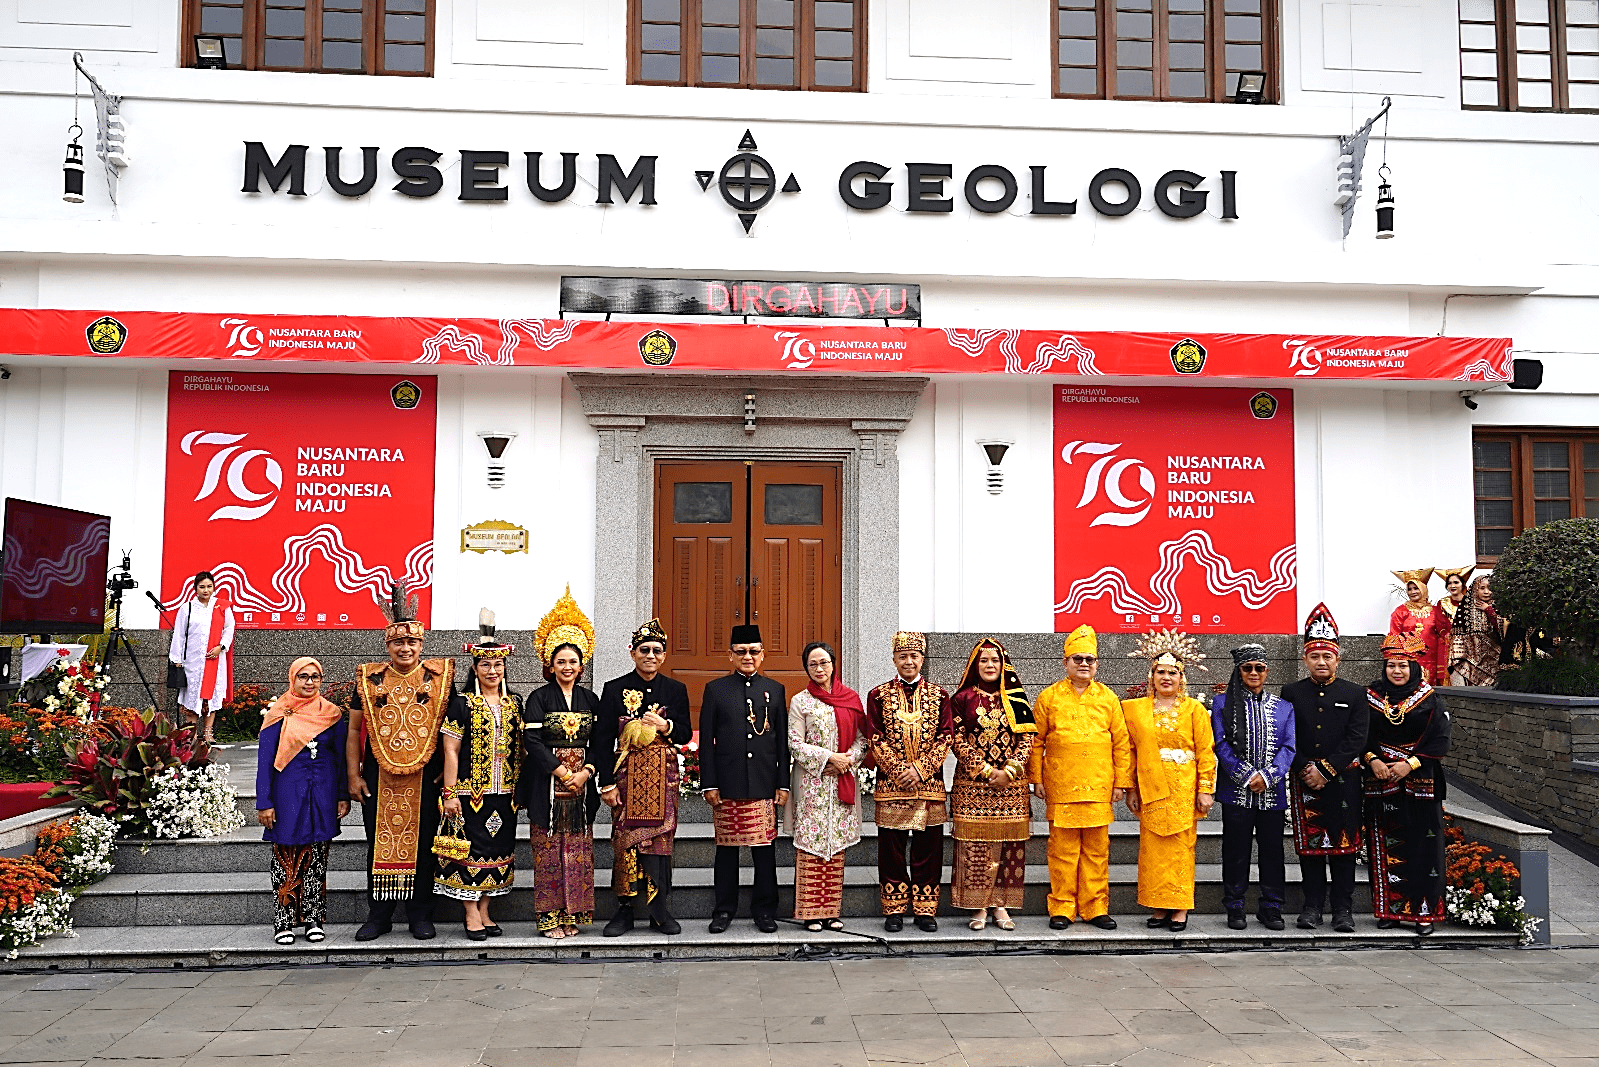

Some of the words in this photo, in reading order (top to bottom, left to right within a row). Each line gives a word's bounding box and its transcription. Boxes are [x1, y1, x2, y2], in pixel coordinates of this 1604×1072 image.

[241, 141, 658, 207] MUSEUM
[839, 160, 1239, 222] GEOLOGI
[706, 281, 908, 316] DIRGAHAYU
[219, 317, 264, 357] 79
[269, 328, 331, 338] NUSANTARA
[333, 329, 362, 339] BARU
[268, 339, 324, 349] INDONESIA
[326, 341, 356, 350] MAJU
[773, 331, 816, 369] 79
[820, 340, 879, 349] NUSANTARA
[881, 341, 907, 350] BARU
[820, 351, 873, 360] INDONESIA
[874, 352, 903, 361] MAJU
[1282, 339, 1322, 376] 79
[1326, 348, 1382, 357] NUSANTARA
[1383, 349, 1409, 358] BARU
[1326, 359, 1376, 368] INDONESIA
[1378, 360, 1405, 369] MAJU
[184, 375, 233, 384] DIRGAHAYU
[184, 383, 223, 391] REPUBLIK
[224, 384, 270, 392] INDONESIA
[1061, 388, 1106, 396] DIRGAHAYU
[1061, 395, 1098, 403] REPUBLIK
[1099, 396, 1140, 404] INDONESIA
[297, 446, 405, 462] NUSANTARA
[297, 462, 345, 477] BARU
[1167, 455, 1266, 470] NUSANTARA
[180, 430, 283, 522] 79
[1167, 471, 1211, 485] BARU
[296, 482, 392, 498] INDONESIA
[1061, 440, 1156, 528] 79
[1167, 490, 1256, 504] INDONESIA
[295, 498, 346, 513] MAJU
[1168, 505, 1214, 519] MAJU
